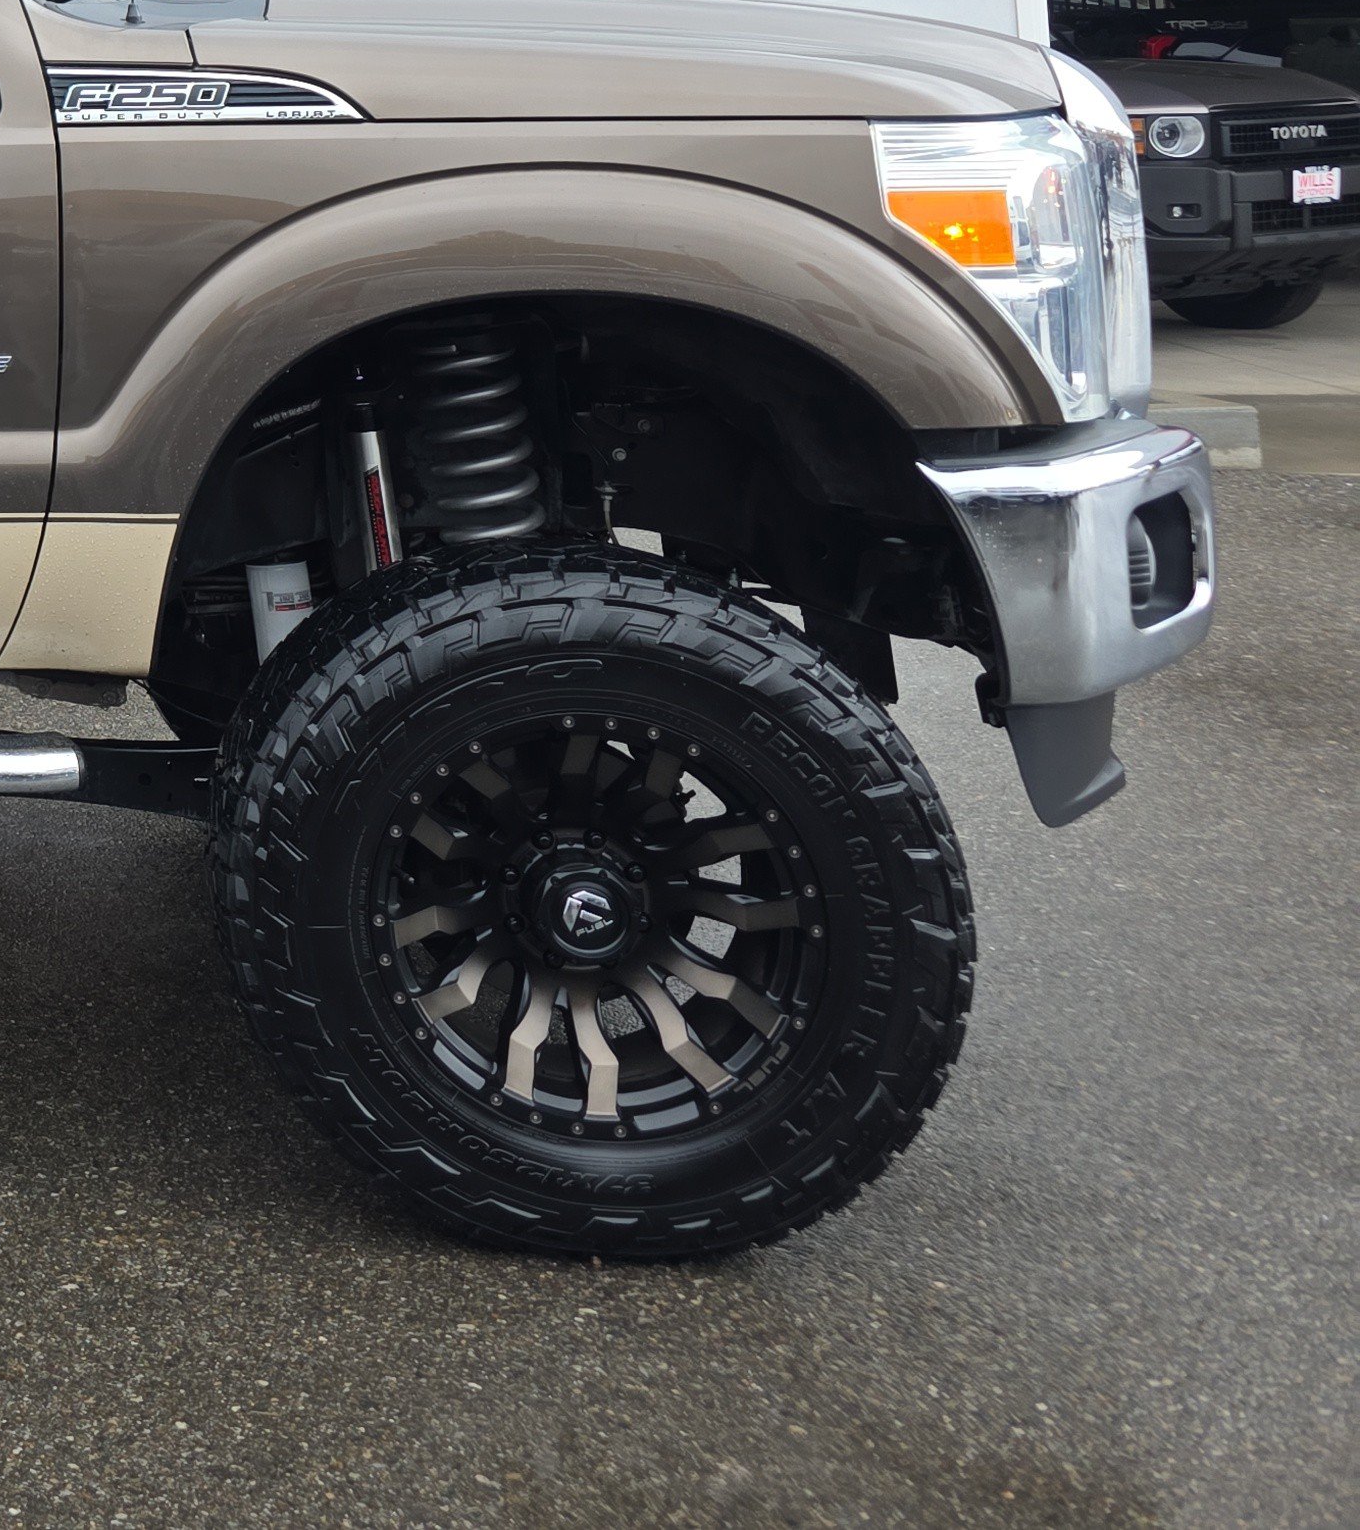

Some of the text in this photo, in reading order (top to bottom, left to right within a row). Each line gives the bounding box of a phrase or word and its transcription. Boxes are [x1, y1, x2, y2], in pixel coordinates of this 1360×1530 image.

[60, 82, 231, 111] F-250
[63, 112, 223, 121] SUPER DUTY
[265, 109, 337, 118] LARIAT
[1271, 125, 1328, 140] TOYOTA
[1298, 173, 1335, 188] WILLS
[575, 918, 615, 938] FUEL
[735, 1040, 791, 1091] FUEL
